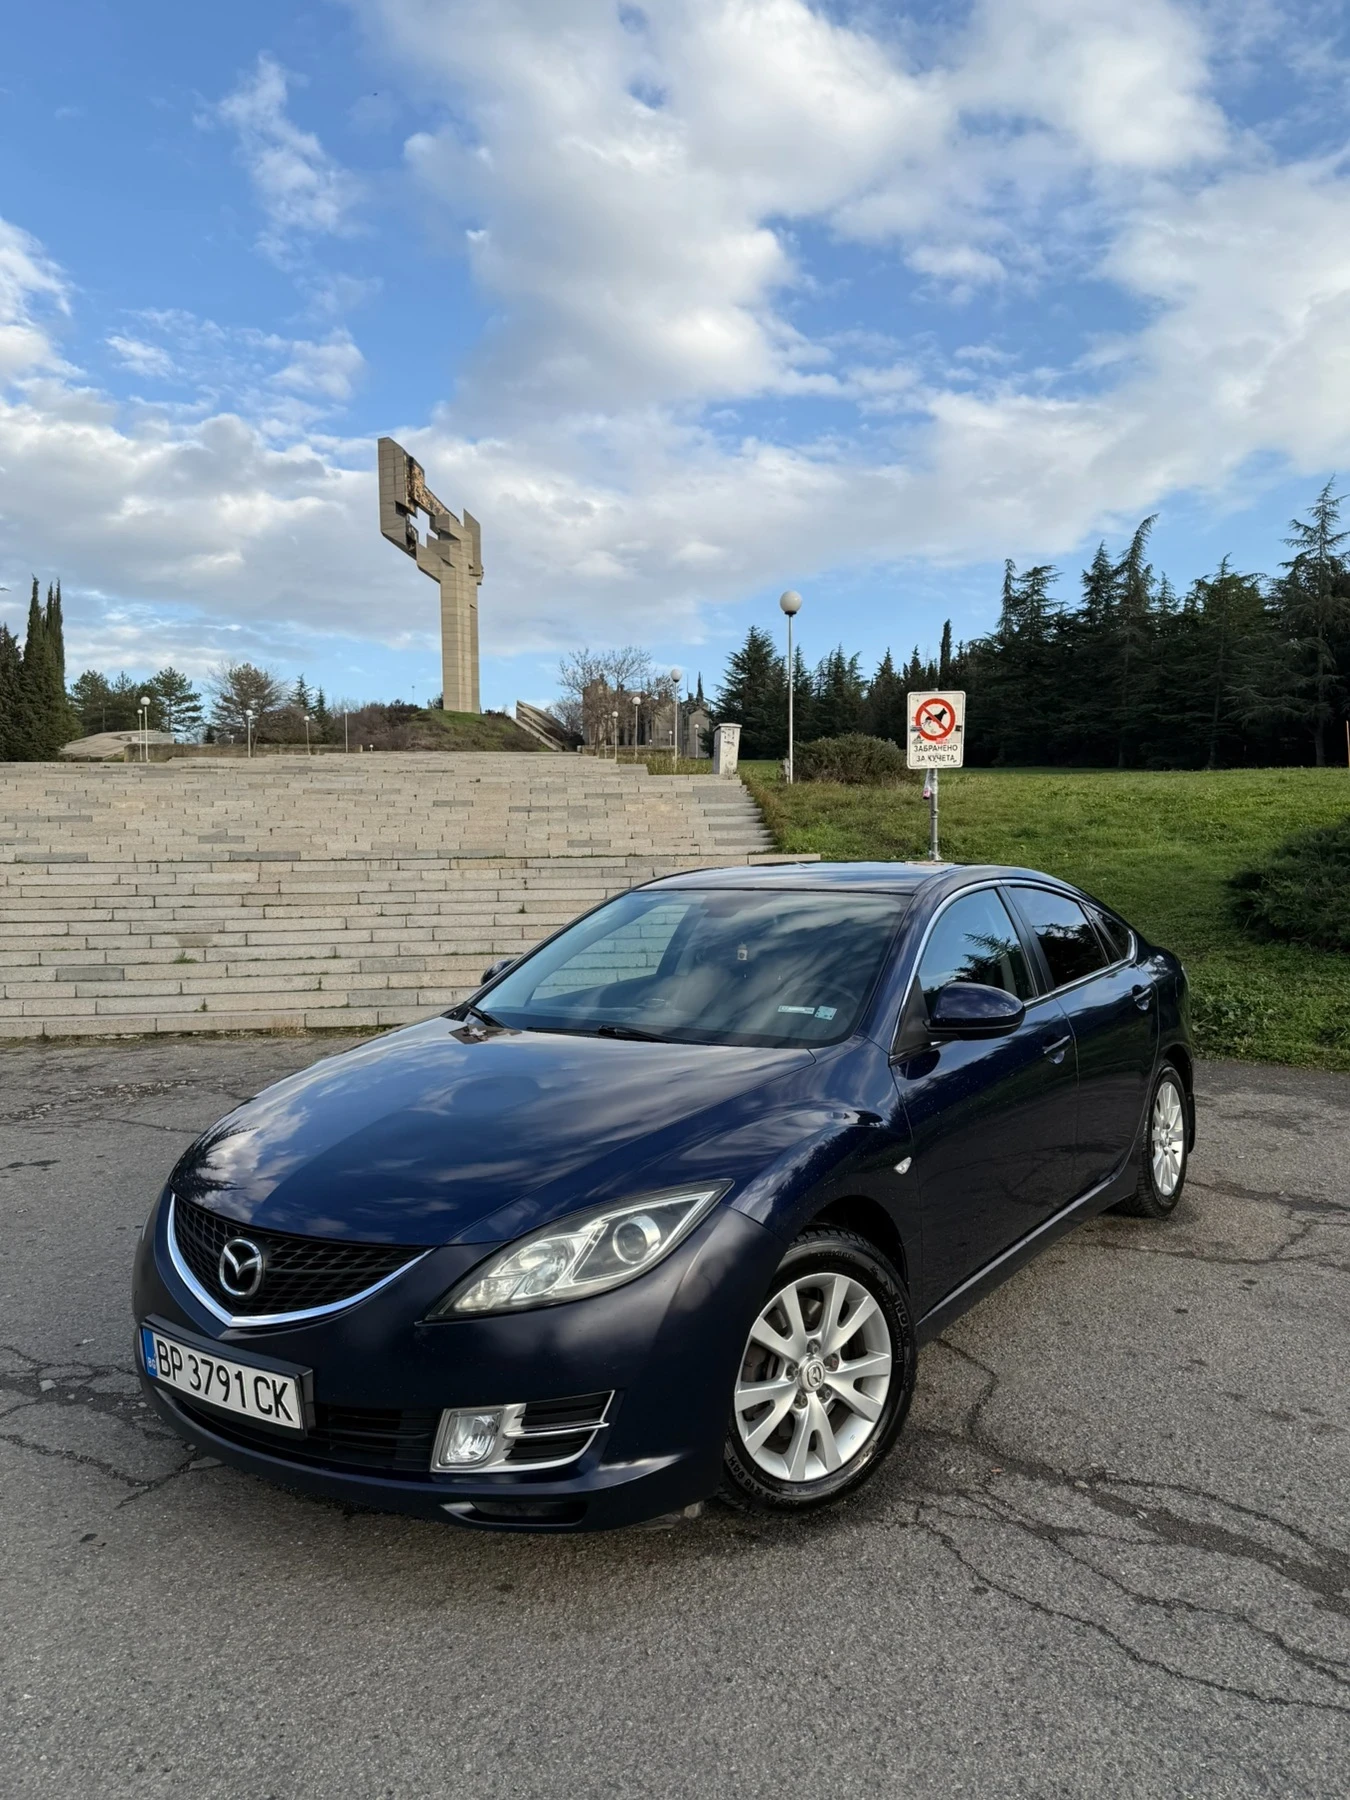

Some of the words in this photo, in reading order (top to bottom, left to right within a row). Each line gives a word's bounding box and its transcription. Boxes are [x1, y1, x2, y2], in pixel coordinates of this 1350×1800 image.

[914, 744, 958, 752] ЗАБРАНЕНО
[928, 754, 955, 762] КУЧЕТА
[156, 1338, 183, 1381] BP
[188, 1354, 247, 1408] 3791
[253, 1376, 294, 1422] CK
